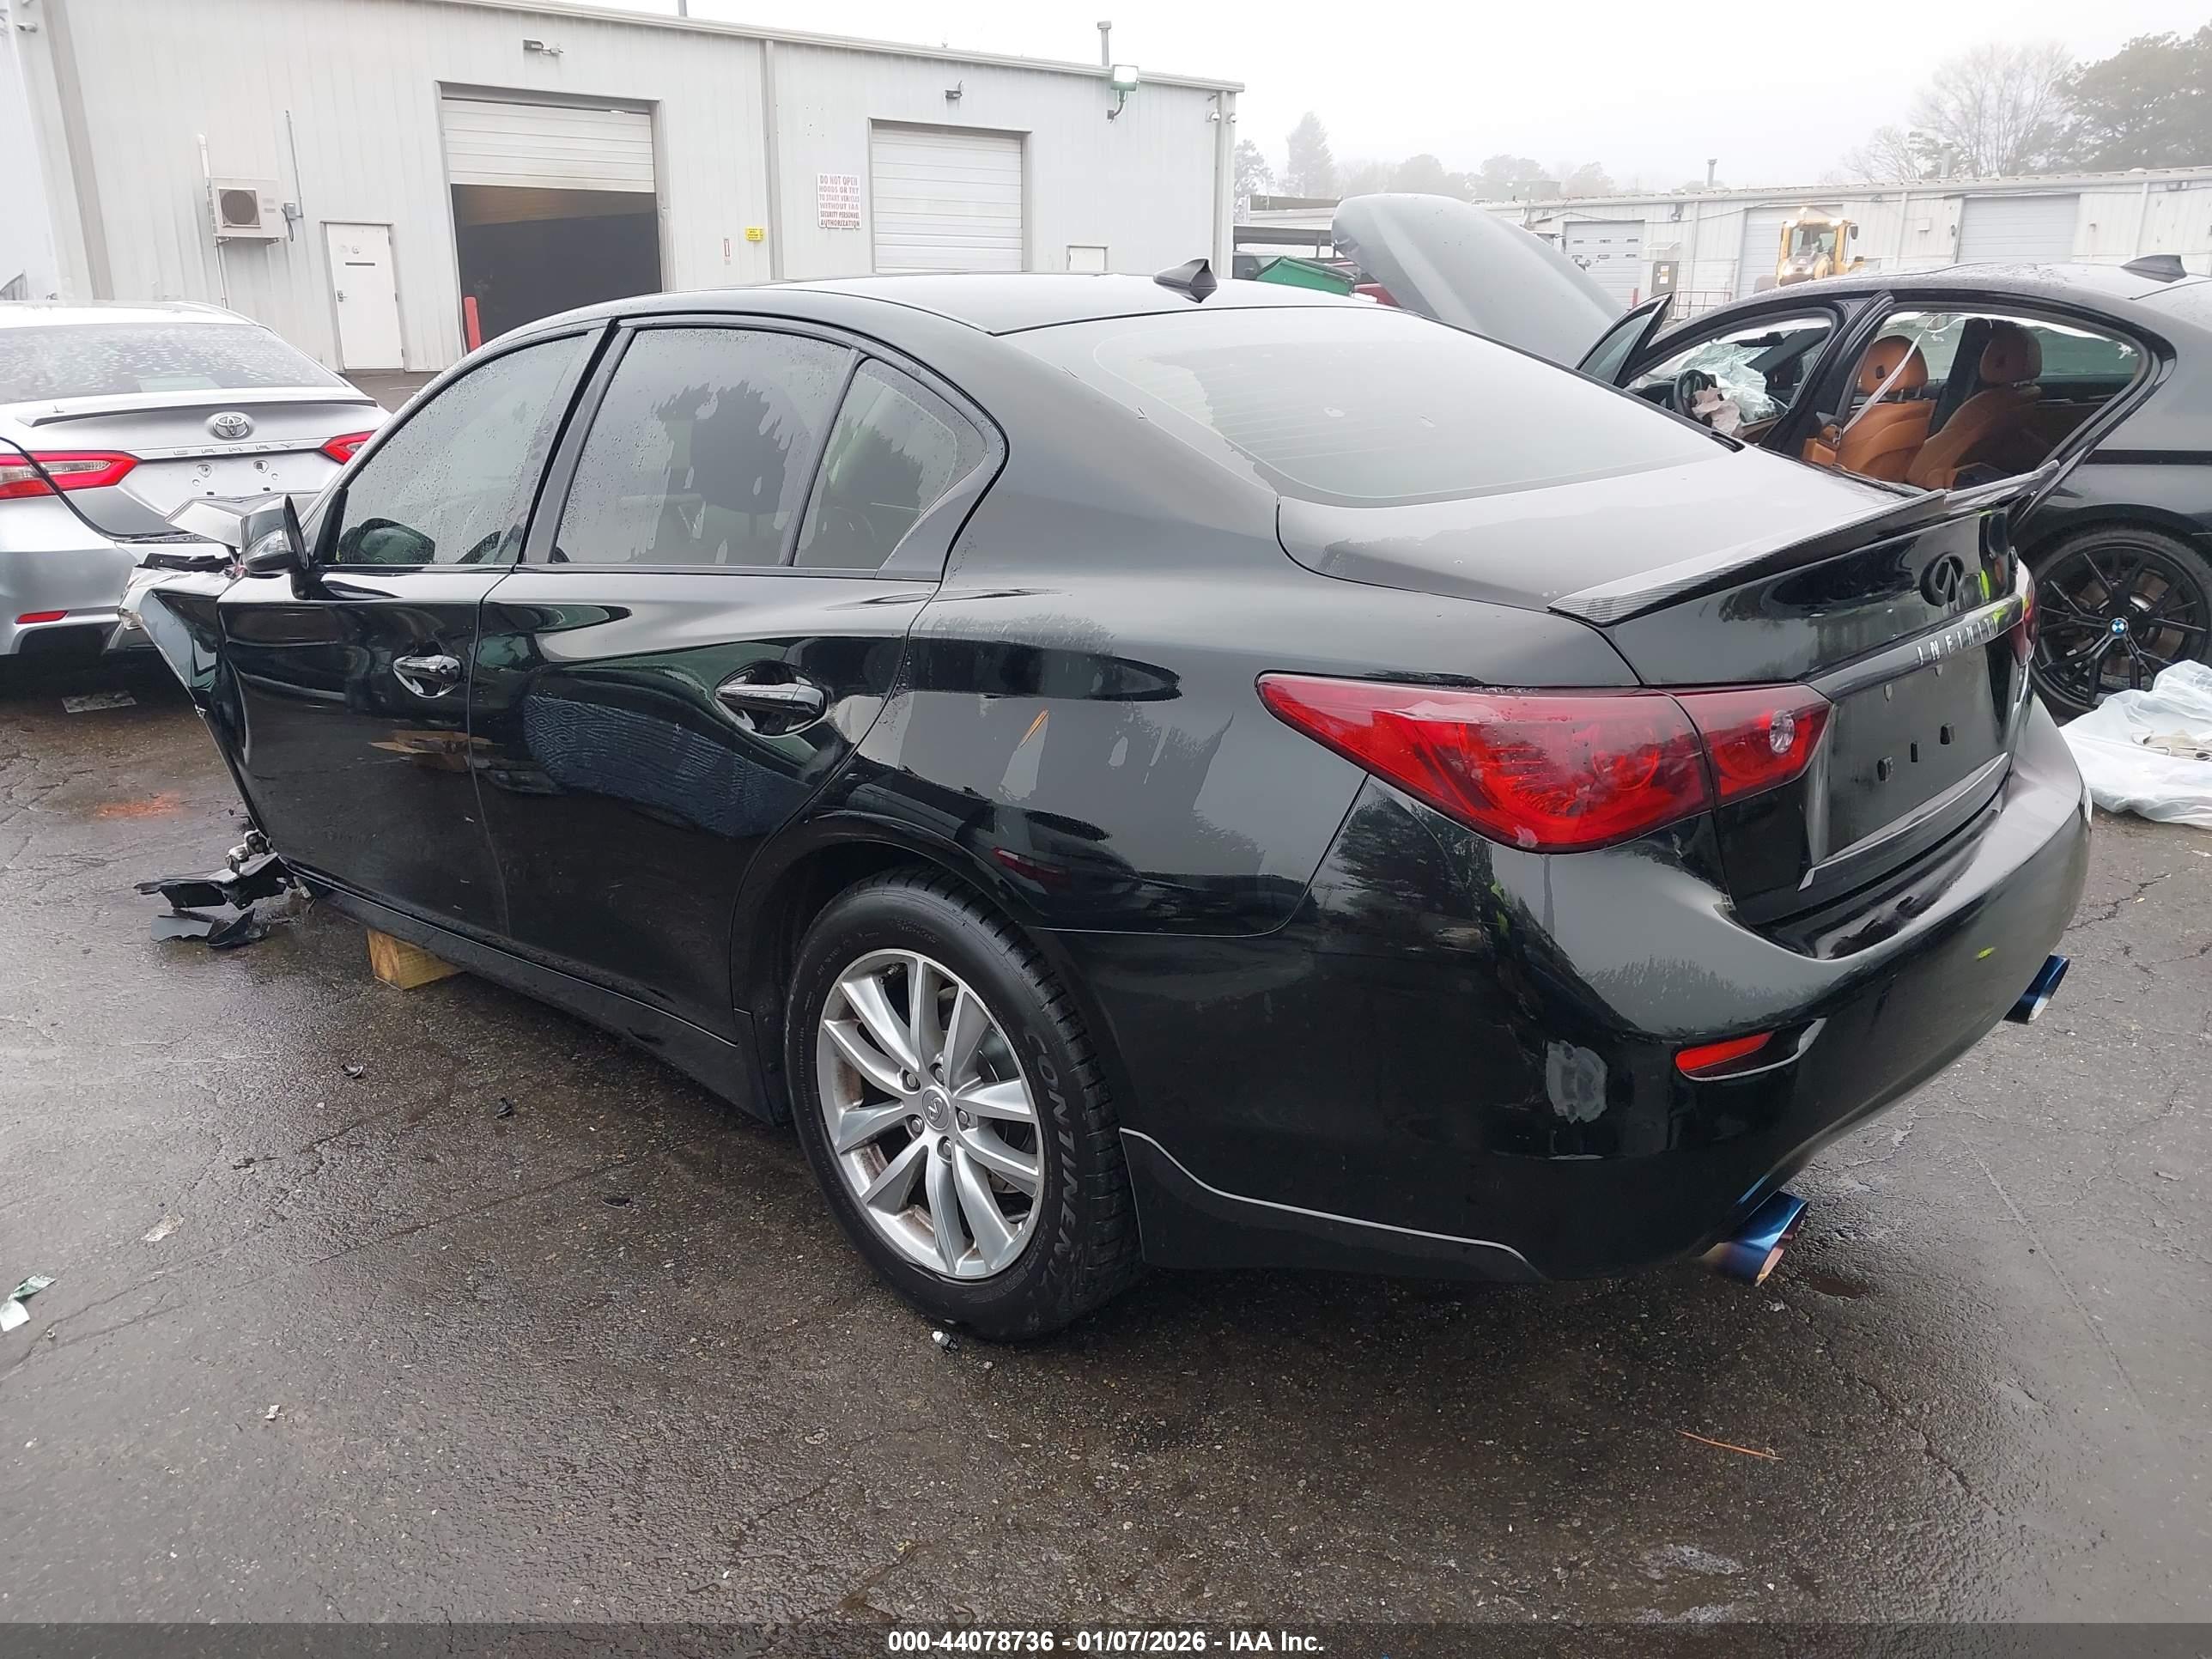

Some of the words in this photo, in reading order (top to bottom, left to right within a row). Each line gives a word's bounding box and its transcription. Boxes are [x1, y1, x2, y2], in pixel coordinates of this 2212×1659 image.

[819, 175, 829, 185] DO
[830, 175, 842, 185] NOT
[843, 176, 857, 185] OPEN
[173, 442, 295, 455] CAMRY
[1917, 617, 1998, 665] INFINITI
